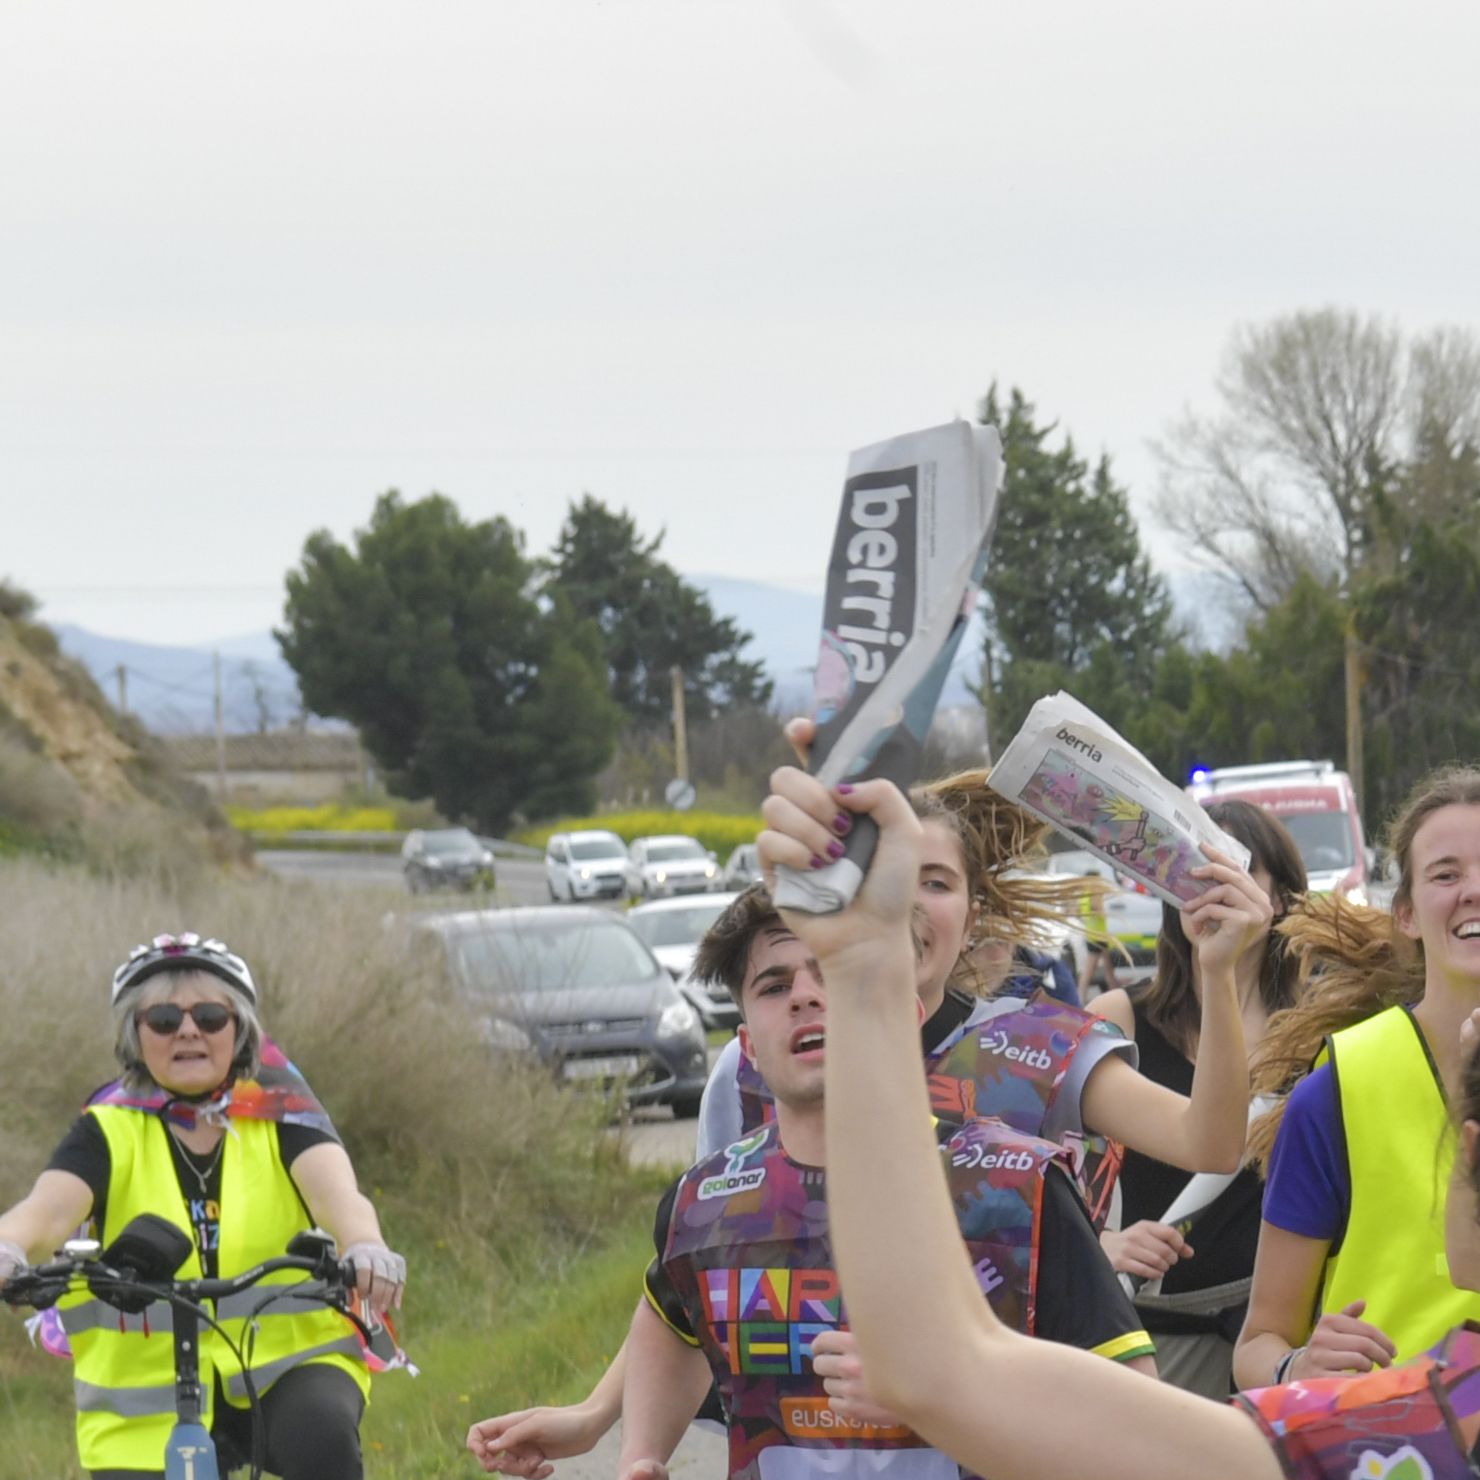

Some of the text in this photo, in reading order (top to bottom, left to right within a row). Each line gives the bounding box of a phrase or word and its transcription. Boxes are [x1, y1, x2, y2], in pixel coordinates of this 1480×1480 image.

[838, 484, 912, 684] berria
[1055, 727, 1103, 763] berria
[1004, 1044, 1052, 1071] eitb
[982, 1148, 1034, 1171] eitb
[702, 1171, 763, 1196] goianar
